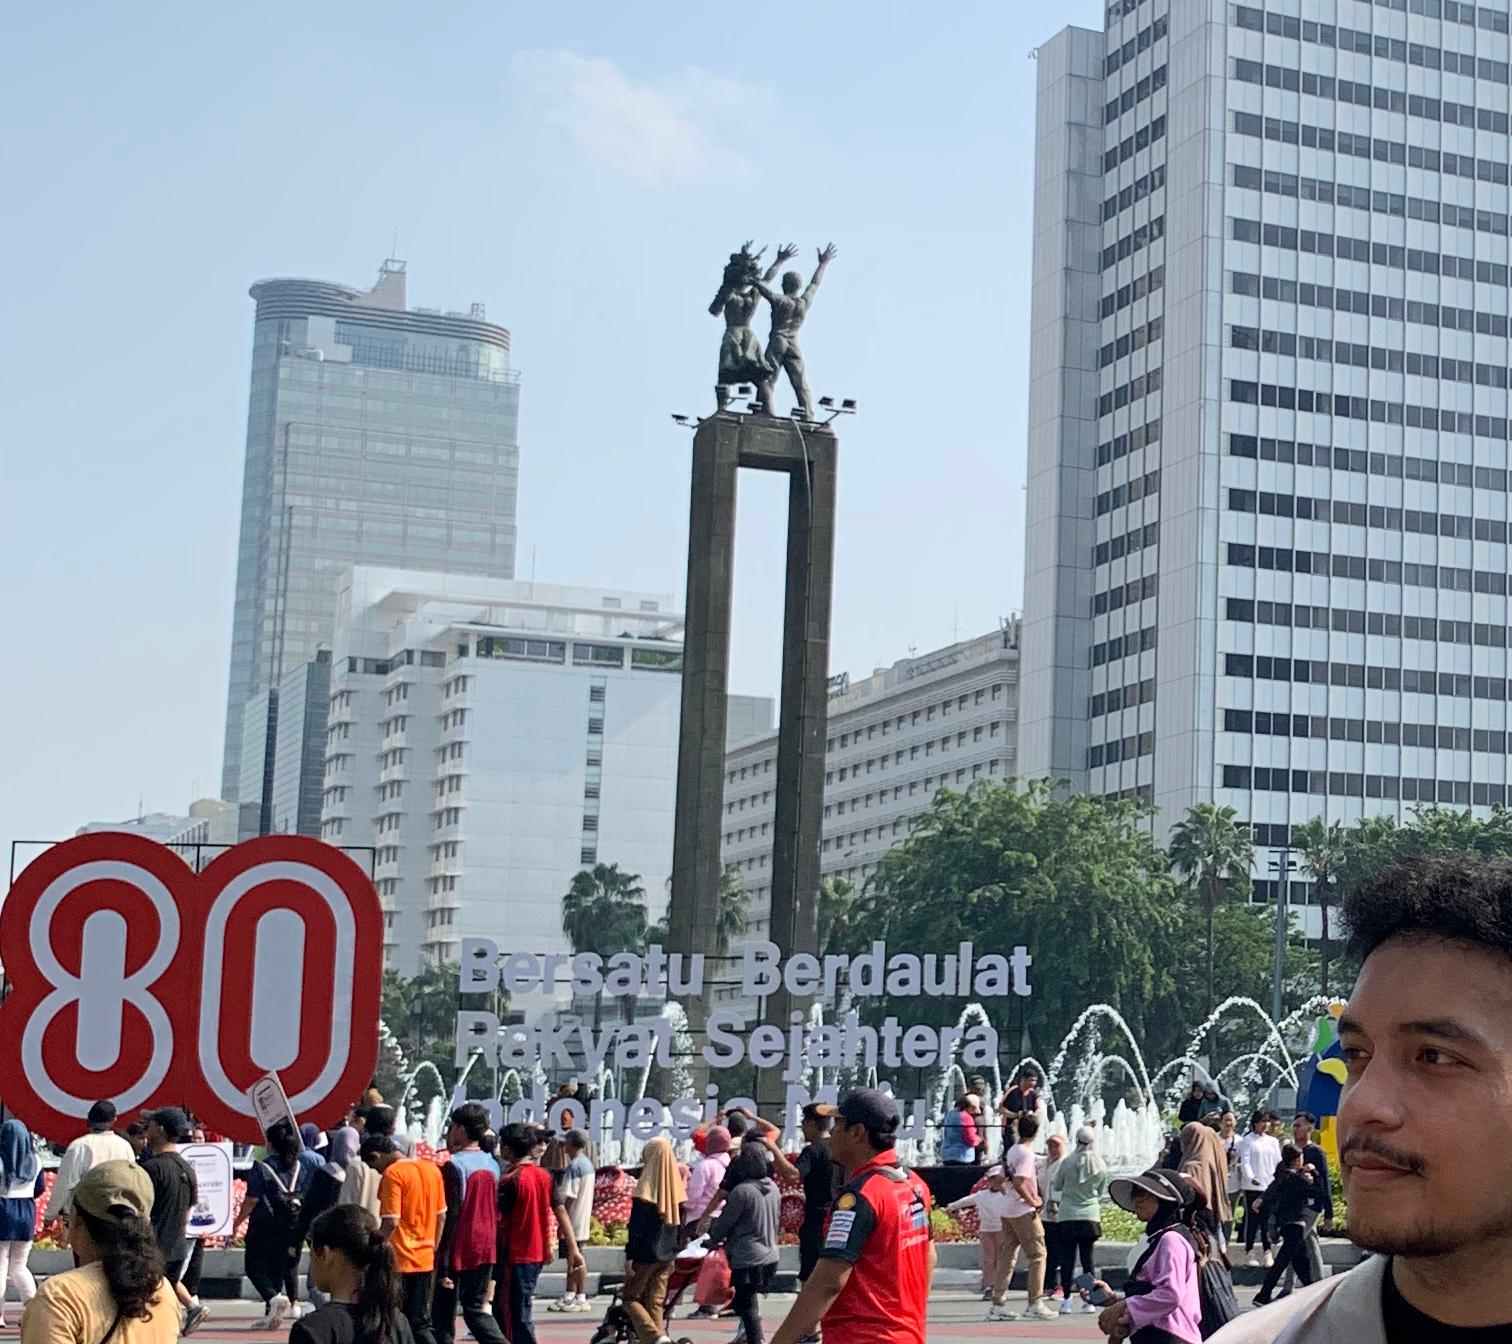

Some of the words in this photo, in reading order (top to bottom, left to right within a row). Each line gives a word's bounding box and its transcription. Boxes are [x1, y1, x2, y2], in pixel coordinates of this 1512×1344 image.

[21, 859, 356, 1119] 80
[459, 937, 705, 996] Bersatu
[742, 940, 1032, 997] Berdaulat
[455, 1010, 674, 1081] Rakyat
[702, 1010, 1000, 1081] Sejahtera
[784, 1081, 926, 1140] Mu
